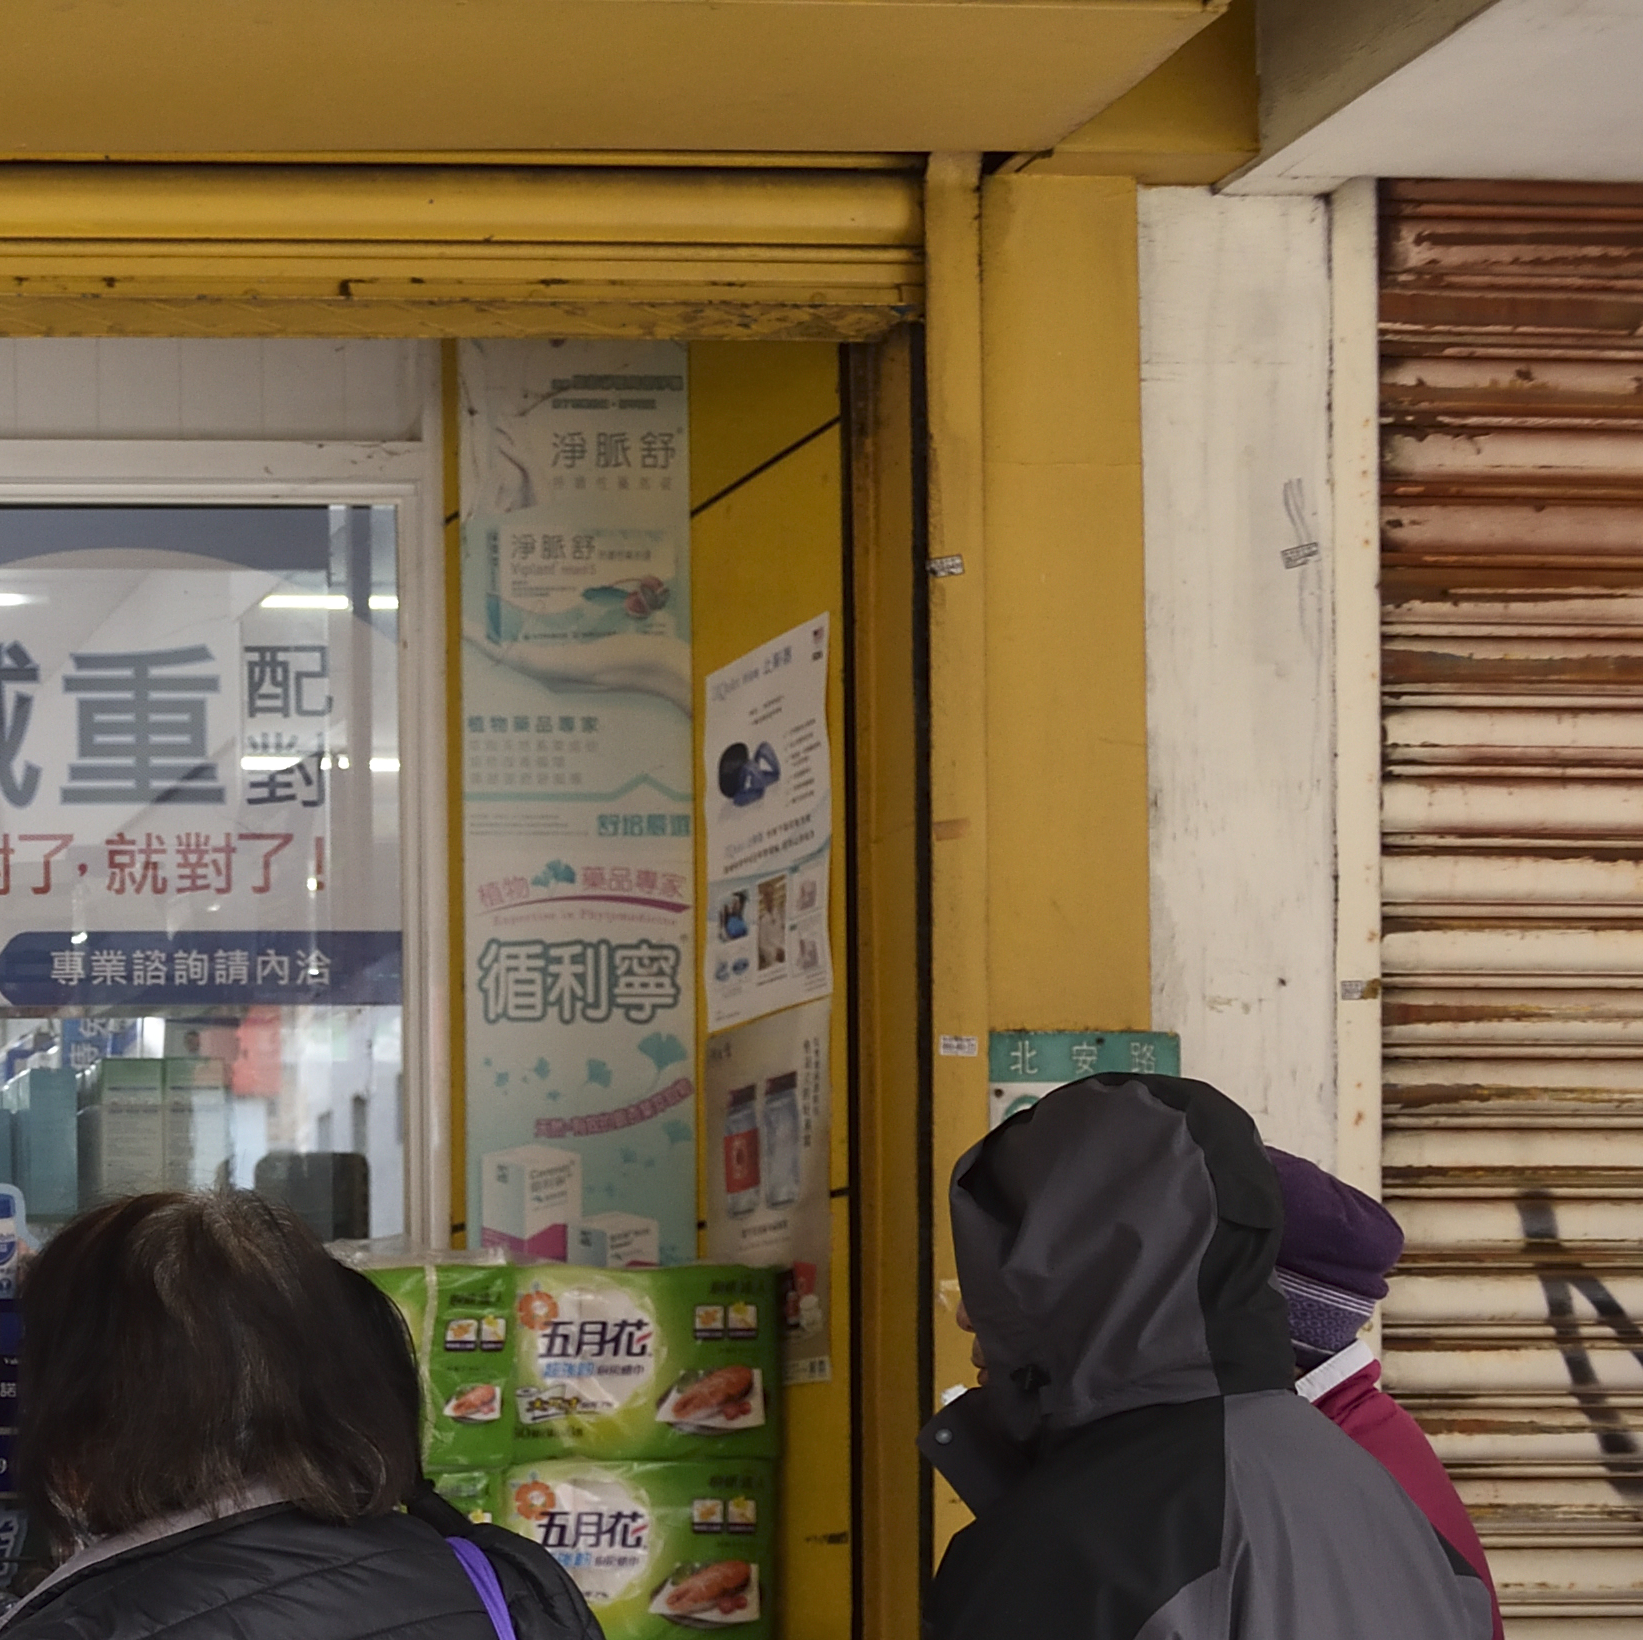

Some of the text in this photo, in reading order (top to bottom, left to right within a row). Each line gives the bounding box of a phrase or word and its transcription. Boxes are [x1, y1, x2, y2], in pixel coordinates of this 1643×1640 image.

[551, 431, 676, 469] 淨脈舒
[241, 643, 333, 808] 配對
[49, 948, 334, 988] 專業諮詢請內洽
[477, 938, 681, 1025] 循利寧
[1010, 1040, 1156, 1074] 北安路
[538, 1319, 653, 1358] 五月花
[536, 1511, 648, 1549] 五月花
[555, 1552, 592, 1568] 強韌
